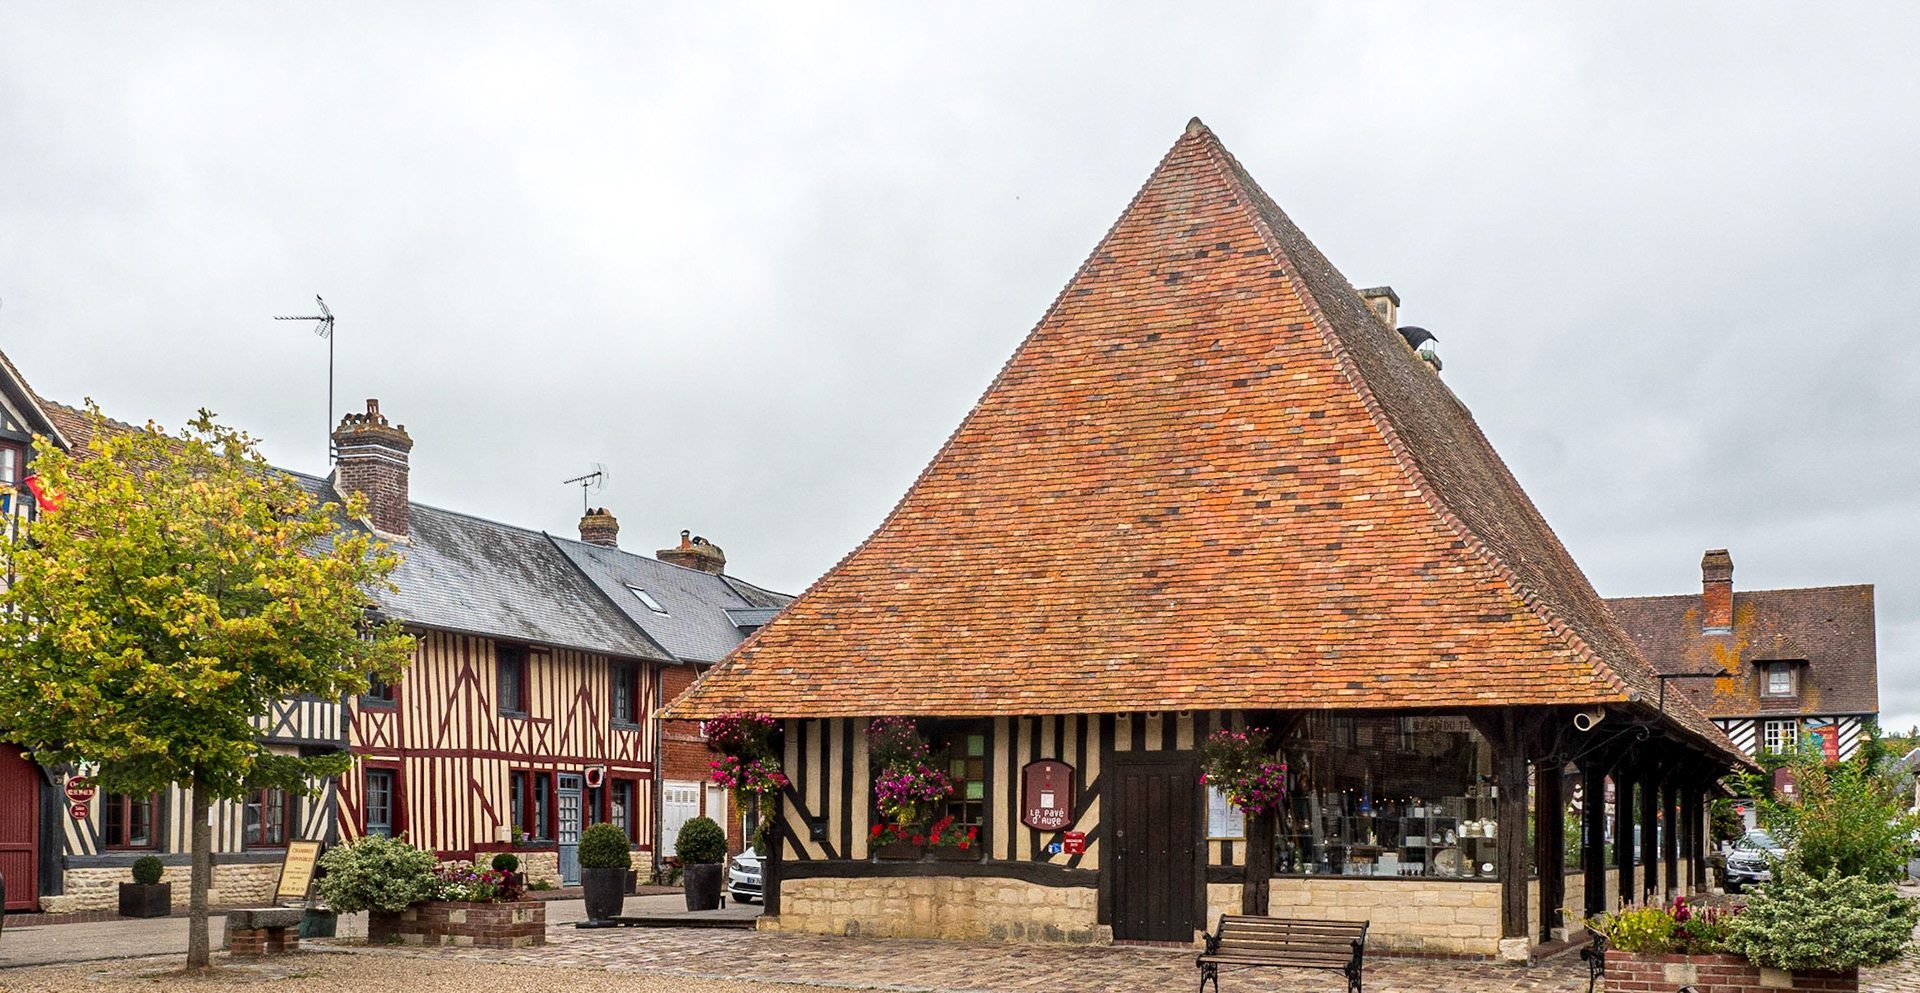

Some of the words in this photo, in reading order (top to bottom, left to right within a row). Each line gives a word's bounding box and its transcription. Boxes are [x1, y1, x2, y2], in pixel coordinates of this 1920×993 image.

[1030, 809, 1040, 817] Le
[1044, 808, 1064, 818] Pavé
[1032, 814, 1062, 828] d'Auge
